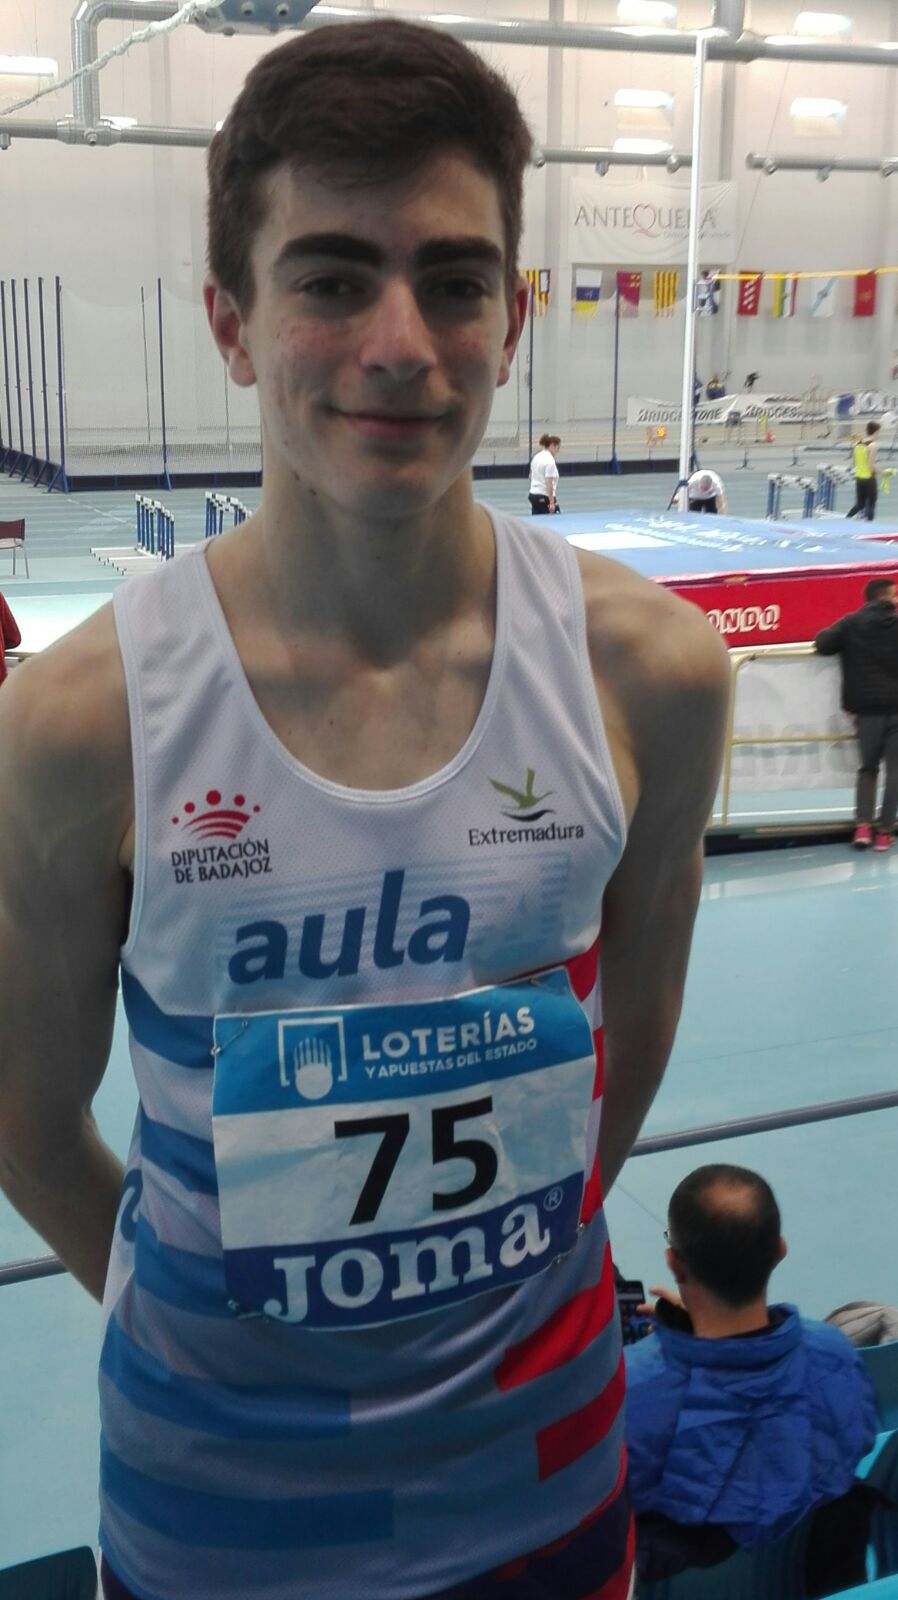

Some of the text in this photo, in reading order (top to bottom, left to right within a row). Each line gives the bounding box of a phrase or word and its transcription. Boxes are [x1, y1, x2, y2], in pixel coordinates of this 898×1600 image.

[573, 202, 717, 238] ANTEQUEA
[638, 407, 722, 422] BRIDGTONE
[705, 604, 781, 634] ONDO
[468, 823, 585, 846] Extremadura
[171, 838, 269, 867] DIPUTACIÓN
[174, 856, 272, 884] DE BADAJOZ
[228, 869, 471, 985] aula
[362, 1006, 535, 1060] LOTERÍAS
[366, 1037, 537, 1079] Y APUESTAS DEL ESTADO
[334, 1095, 499, 1227] 75
